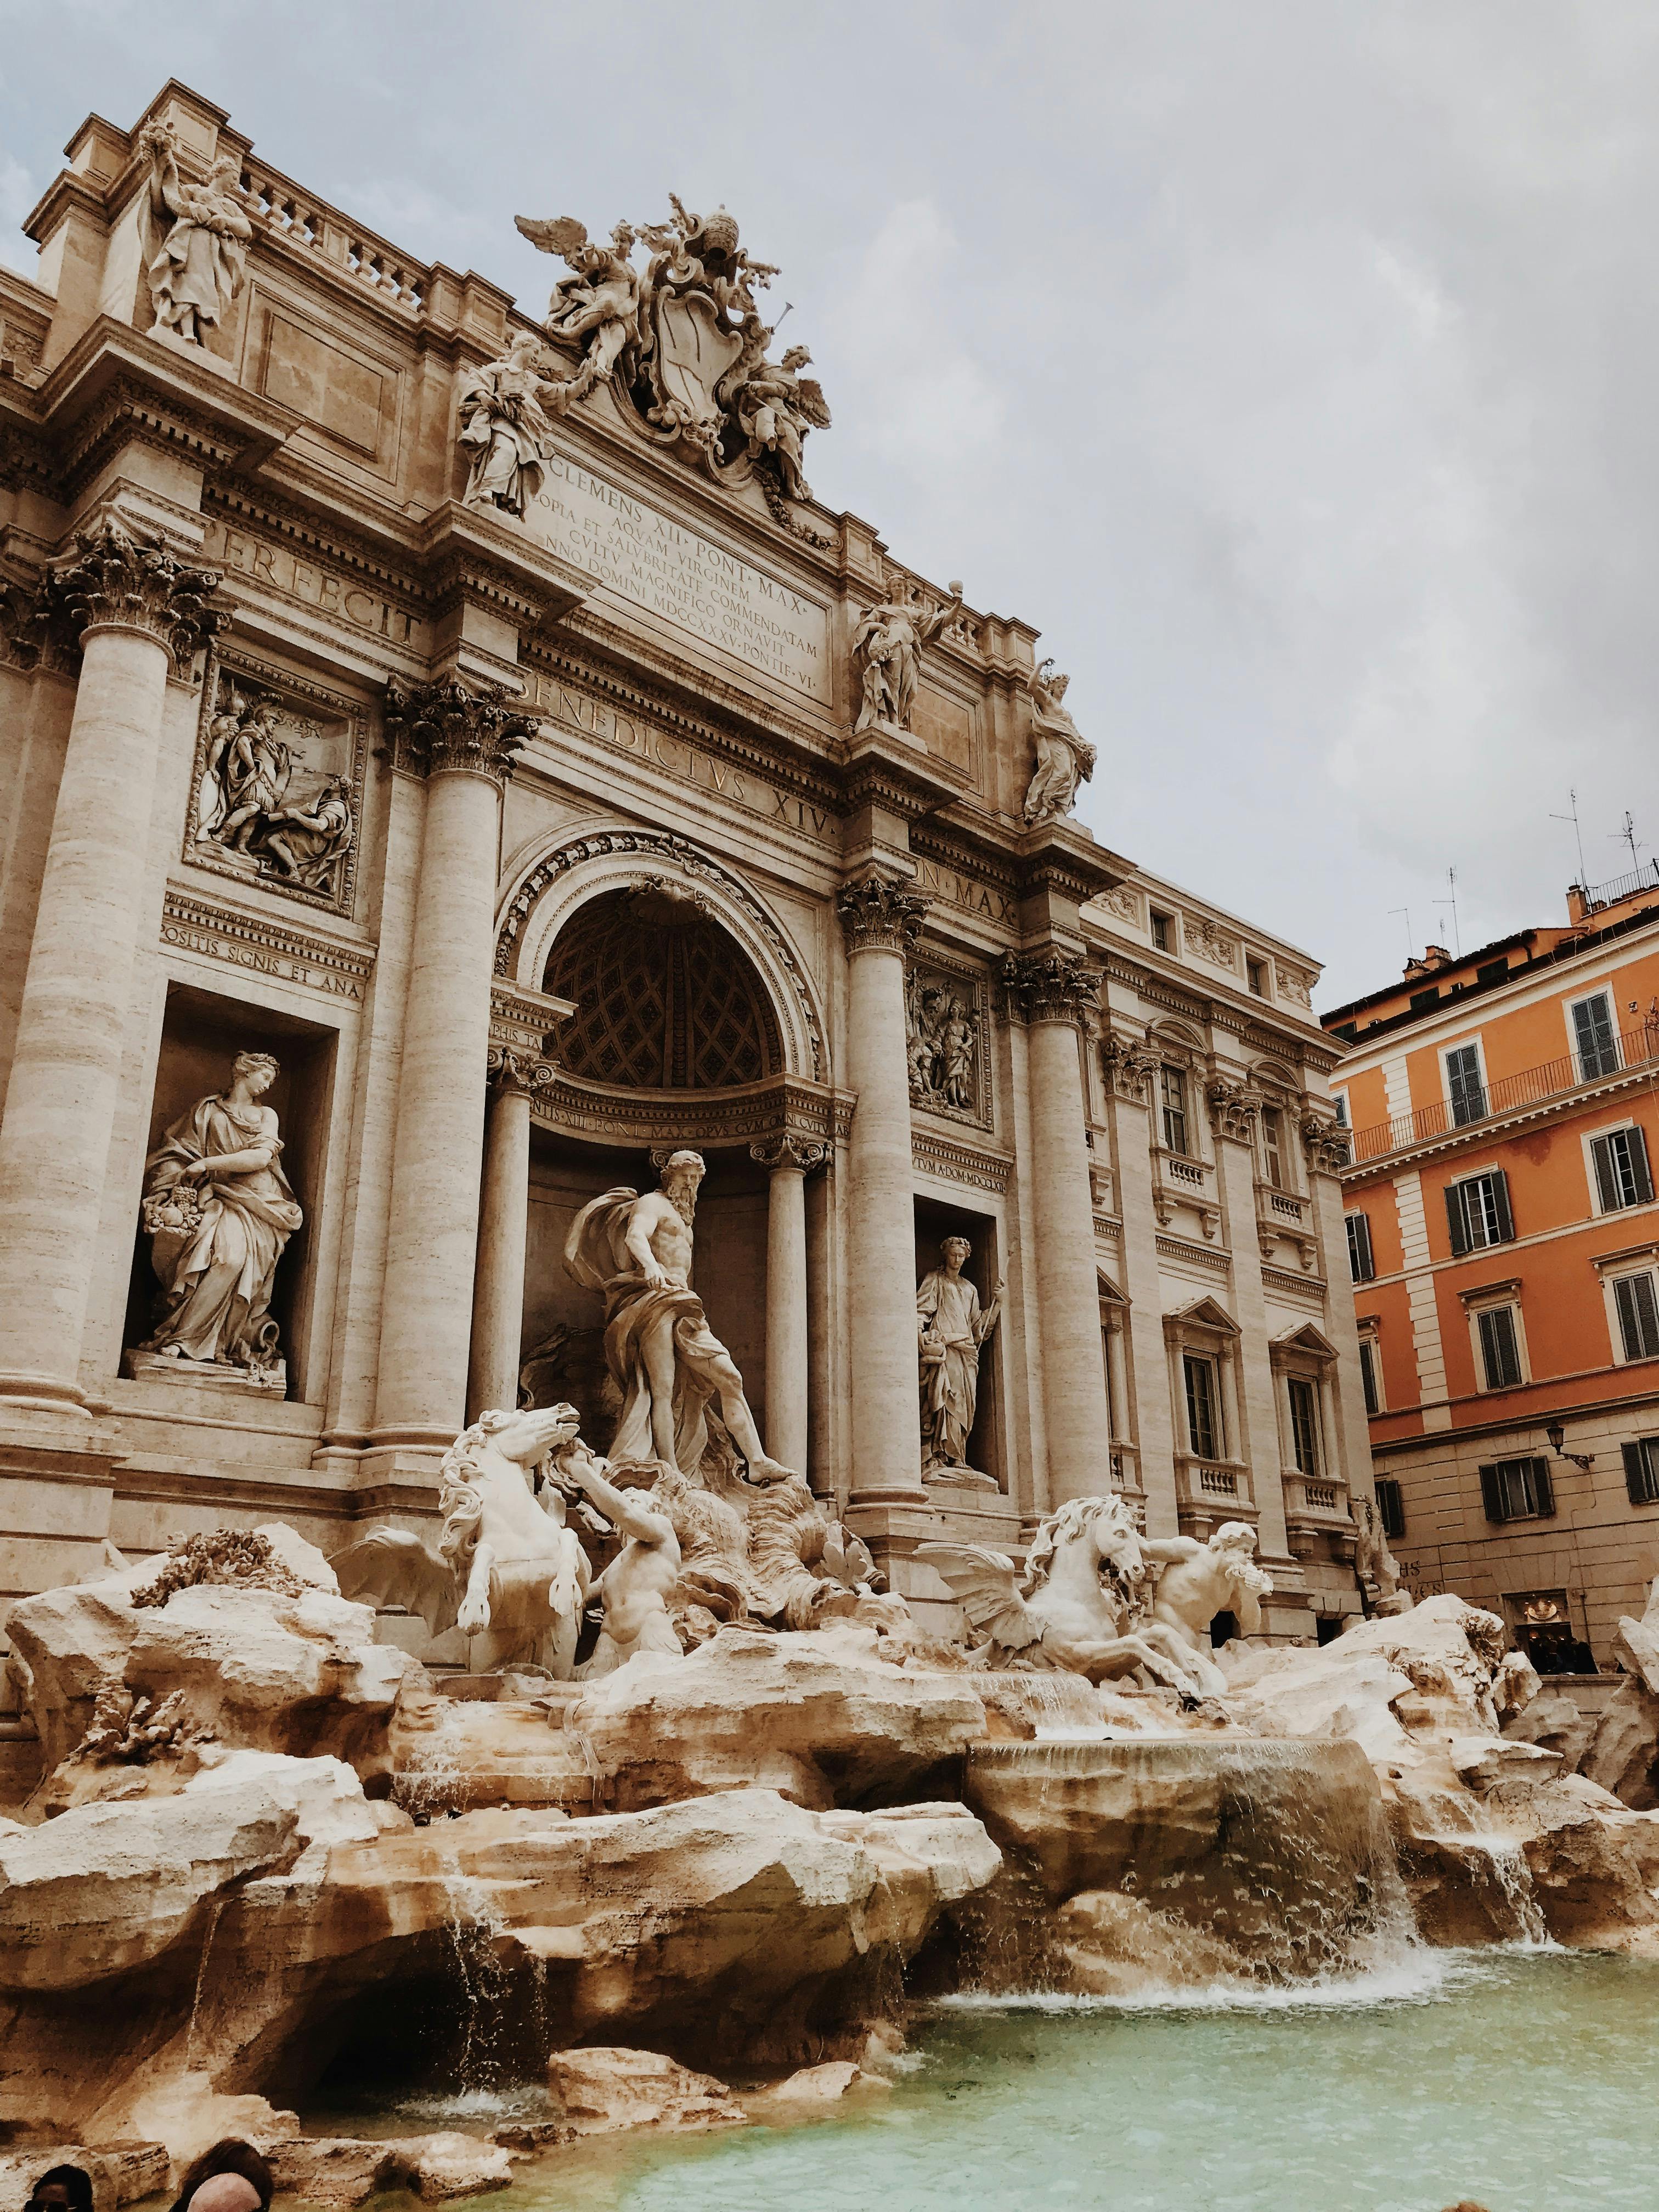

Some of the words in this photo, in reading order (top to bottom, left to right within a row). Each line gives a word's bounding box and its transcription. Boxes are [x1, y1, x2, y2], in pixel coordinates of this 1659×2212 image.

[549, 458, 642, 522] CLEMENS
[546, 534, 582, 564] NNO
[588, 557, 646, 599] DOMINI
[583, 517, 602, 537] ET
[607, 531, 703, 594] SALVBRITATE
[710, 590, 817, 658] COMMENDATAM
[612, 517, 668, 556] AQVAM
[678, 552, 750, 603] VIRGINEM
[569, 530, 621, 565] CVLTV
[631, 562, 715, 618] MAGNIFICO
[723, 614, 785, 657] ORNAVIT
[228, 946, 280, 974] SIGNIS
[291, 964, 311, 983] ET
[320, 976, 360, 998] ANA
[488, 1023, 518, 1043] PHIS
[524, 1033, 541, 1051] TA
[836, 1124, 851, 1137] AB
